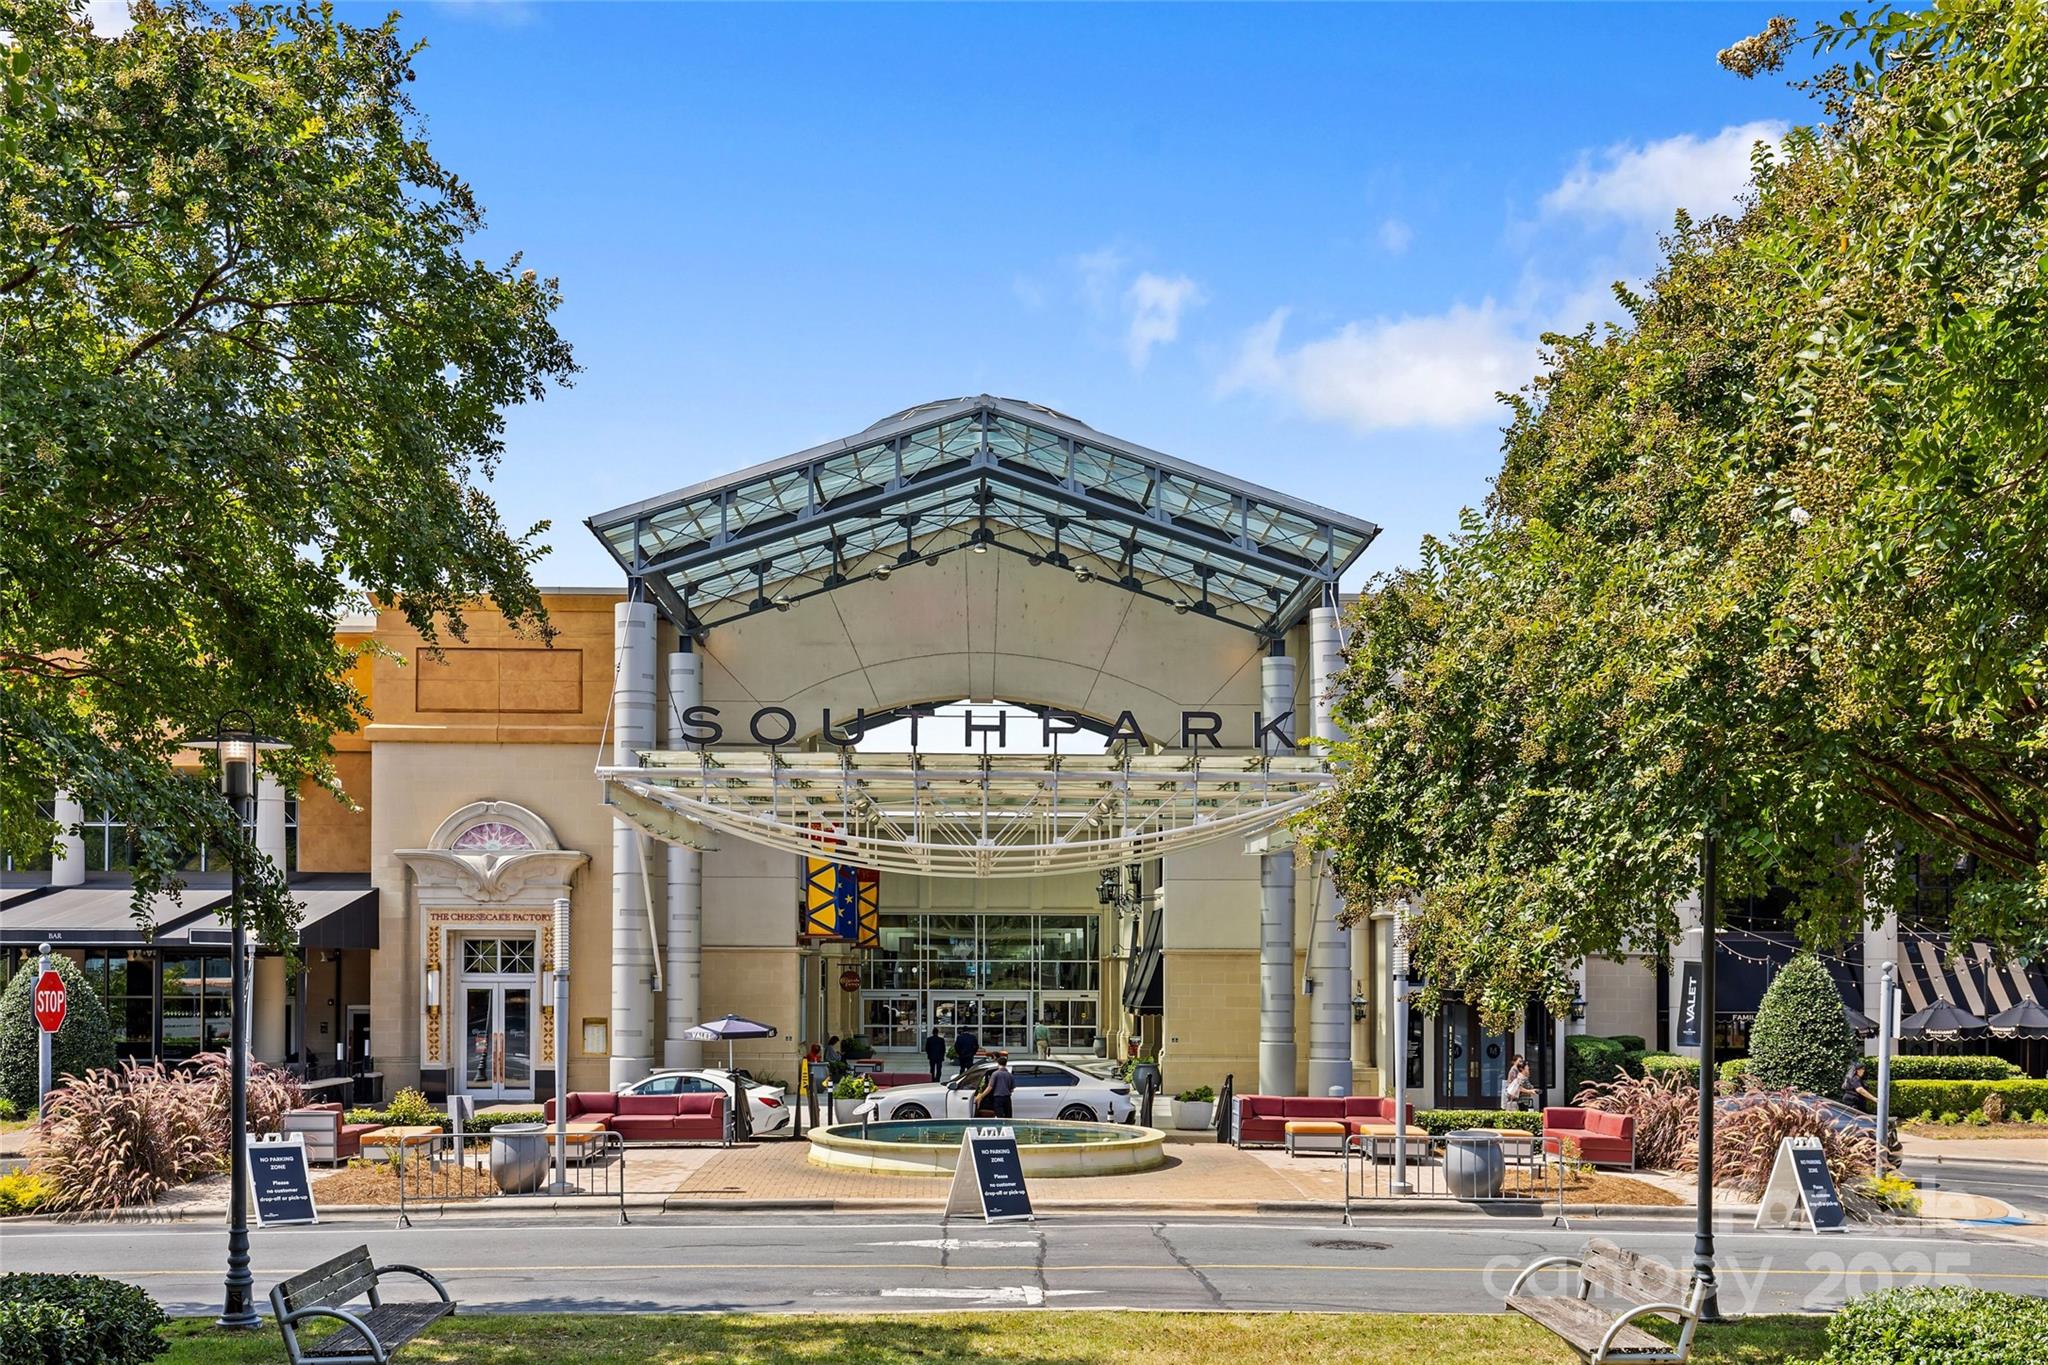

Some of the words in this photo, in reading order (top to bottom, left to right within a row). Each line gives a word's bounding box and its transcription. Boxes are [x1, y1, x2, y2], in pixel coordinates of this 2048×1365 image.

[681, 705, 1296, 748] SOUTHPARK
[451, 913, 511, 921] CHEESECAKE
[37, 991, 64, 1013] STOP
[1686, 976, 1697, 1023] VALET
